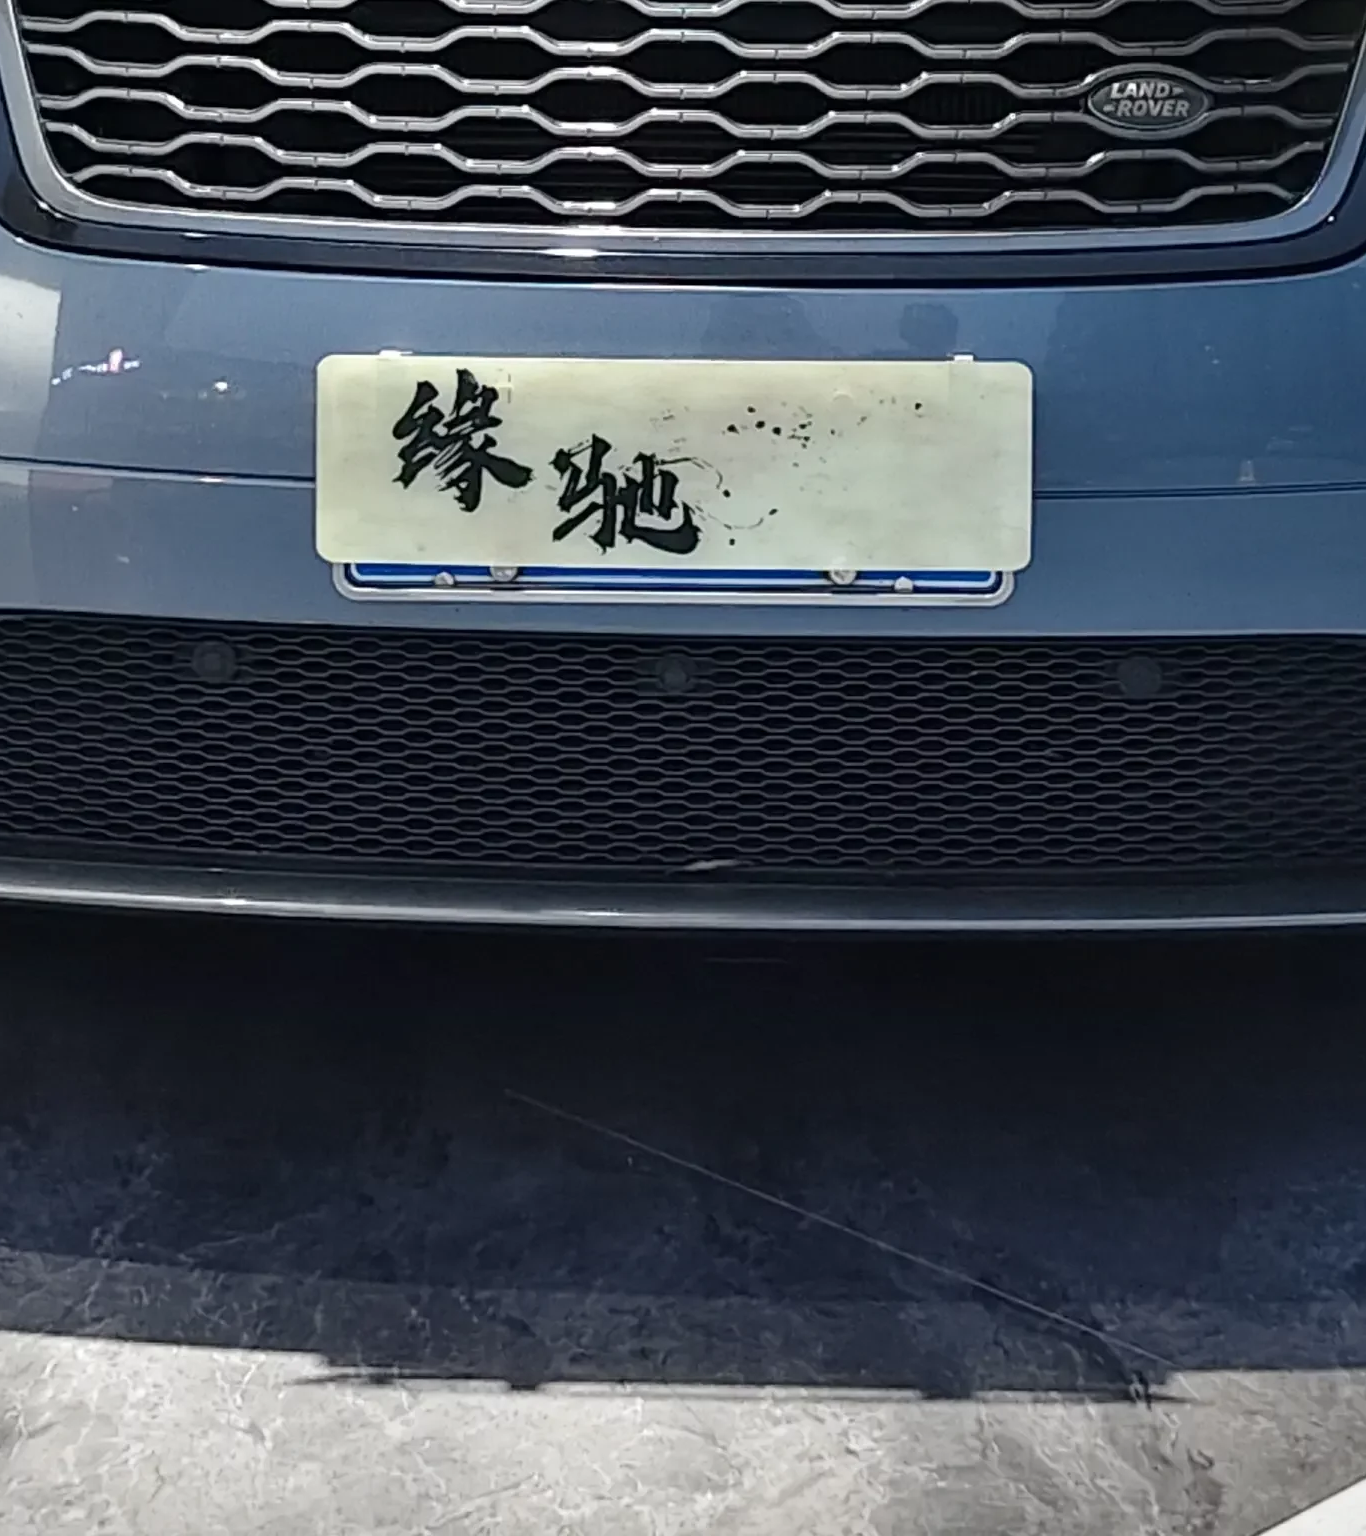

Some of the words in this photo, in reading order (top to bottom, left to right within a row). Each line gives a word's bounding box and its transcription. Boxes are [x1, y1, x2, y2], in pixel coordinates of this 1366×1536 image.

[1110, 81, 1171, 99] LAND
[1116, 99, 1190, 117] ROVER
[391, 367, 702, 556] 缘驰
